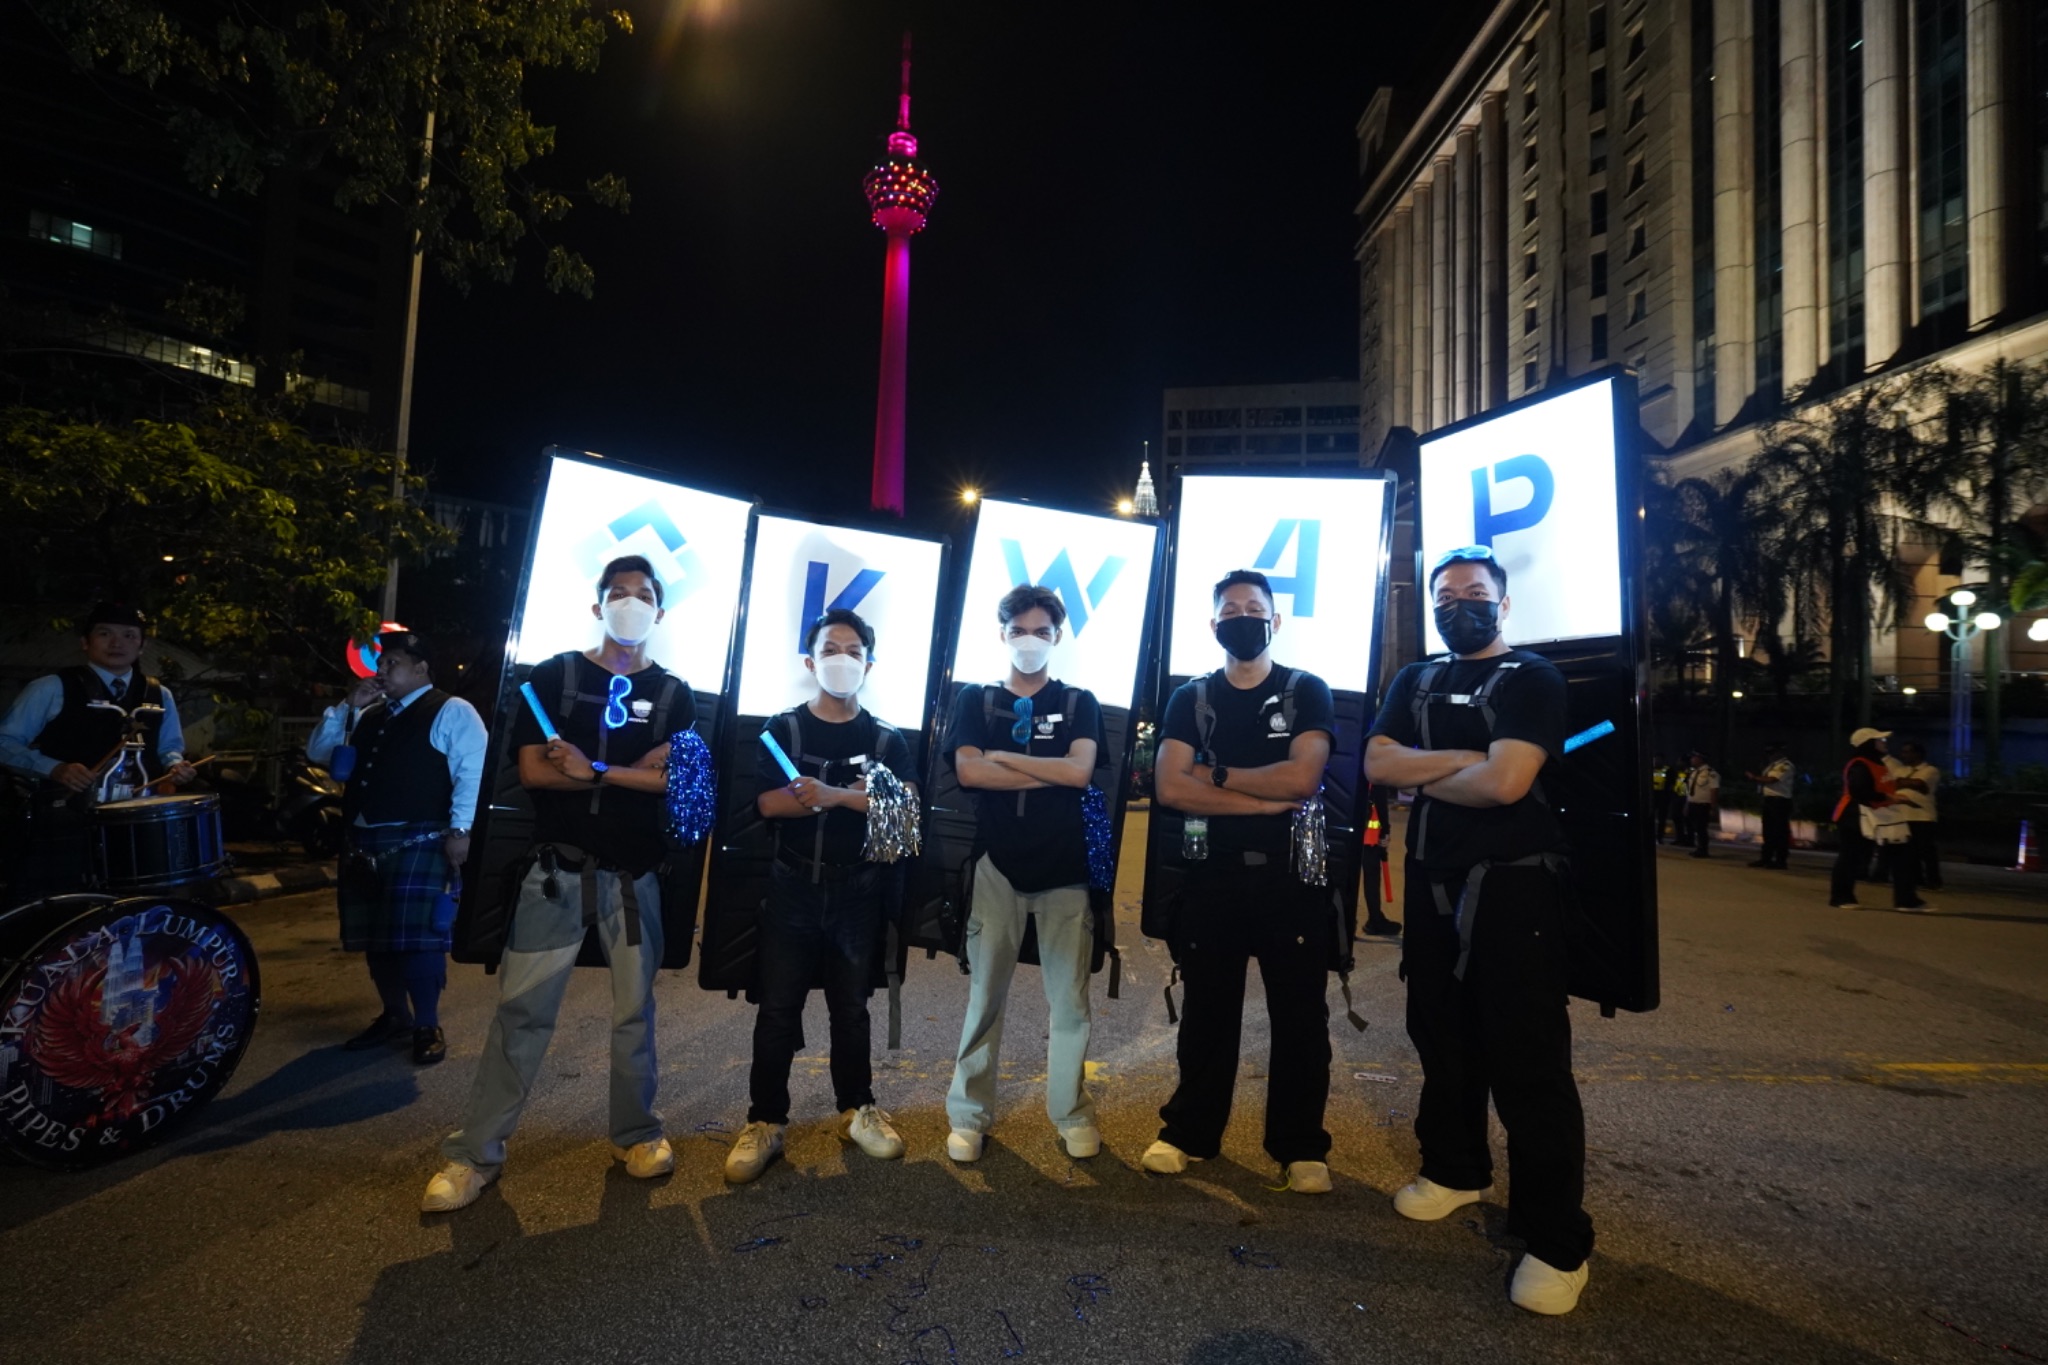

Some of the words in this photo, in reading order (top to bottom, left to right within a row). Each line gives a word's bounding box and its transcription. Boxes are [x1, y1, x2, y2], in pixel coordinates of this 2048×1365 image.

[1471, 454, 1554, 549] P
[799, 561, 886, 662] K
[1000, 538, 1127, 638] W
[1251, 518, 1321, 617] A
[1, 925, 120, 1037] KUALA
[134, 911, 240, 985] LUMPUR
[0, 1080, 87, 1152] PIPES
[99, 1127, 122, 1146] &
[138, 1023, 237, 1133] DRUMS
